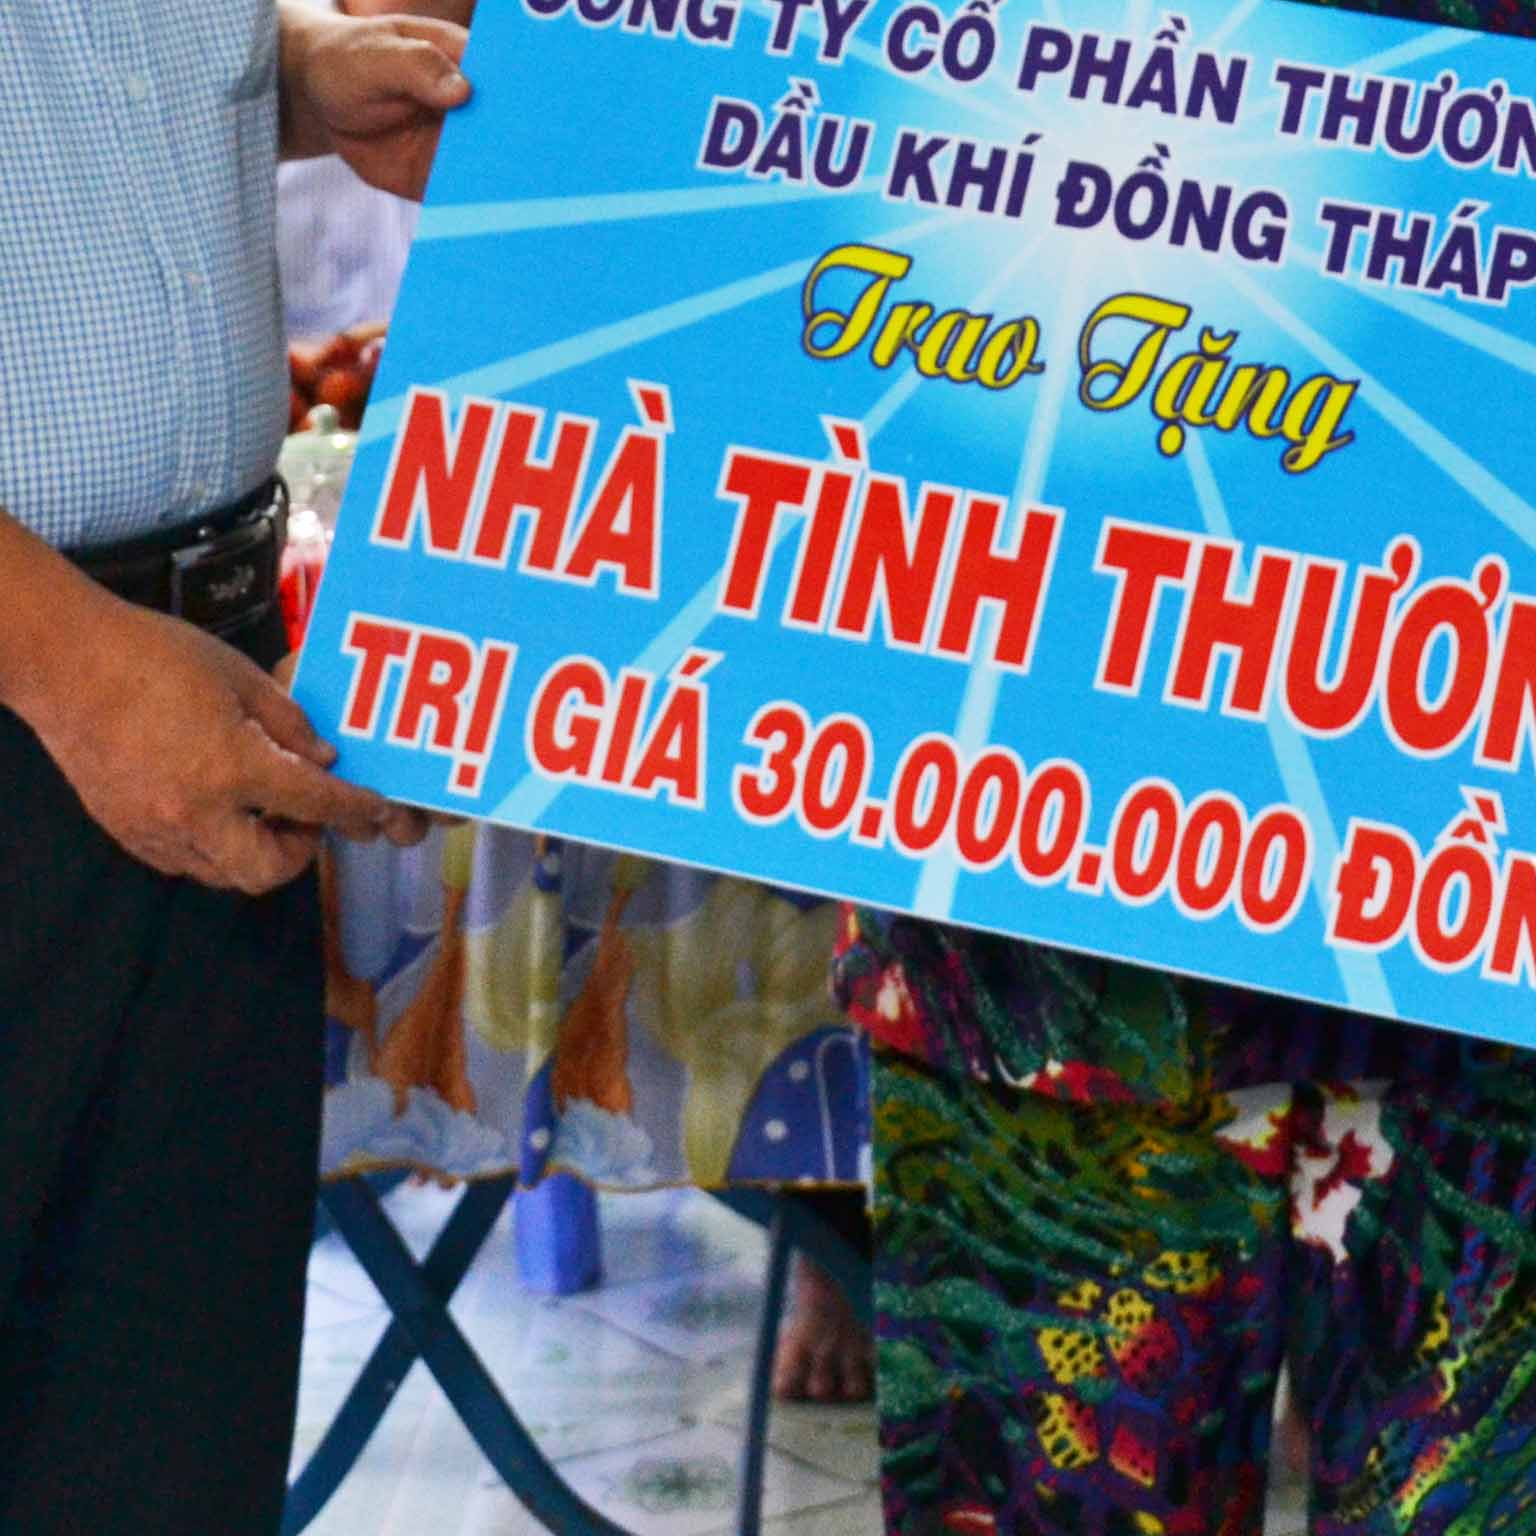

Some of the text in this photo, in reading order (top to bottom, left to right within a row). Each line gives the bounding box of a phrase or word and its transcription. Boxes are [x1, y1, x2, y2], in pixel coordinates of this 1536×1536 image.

[701, 76, 872, 190] DẦU
[886, 130, 1041, 220] KHÍ
[1053, 140, 1290, 265] ĐỒNG
[1014, 9, 1249, 125] PHẦN
[798, 241, 1362, 476] Trao Tặng
[373, 383, 673, 596] NHÀ
[716, 421, 1062, 671] TÌNH
[341, 616, 518, 791] TRỊ
[527, 648, 722, 804] GIÁ
[734, 704, 1311, 930] 30.000.000
